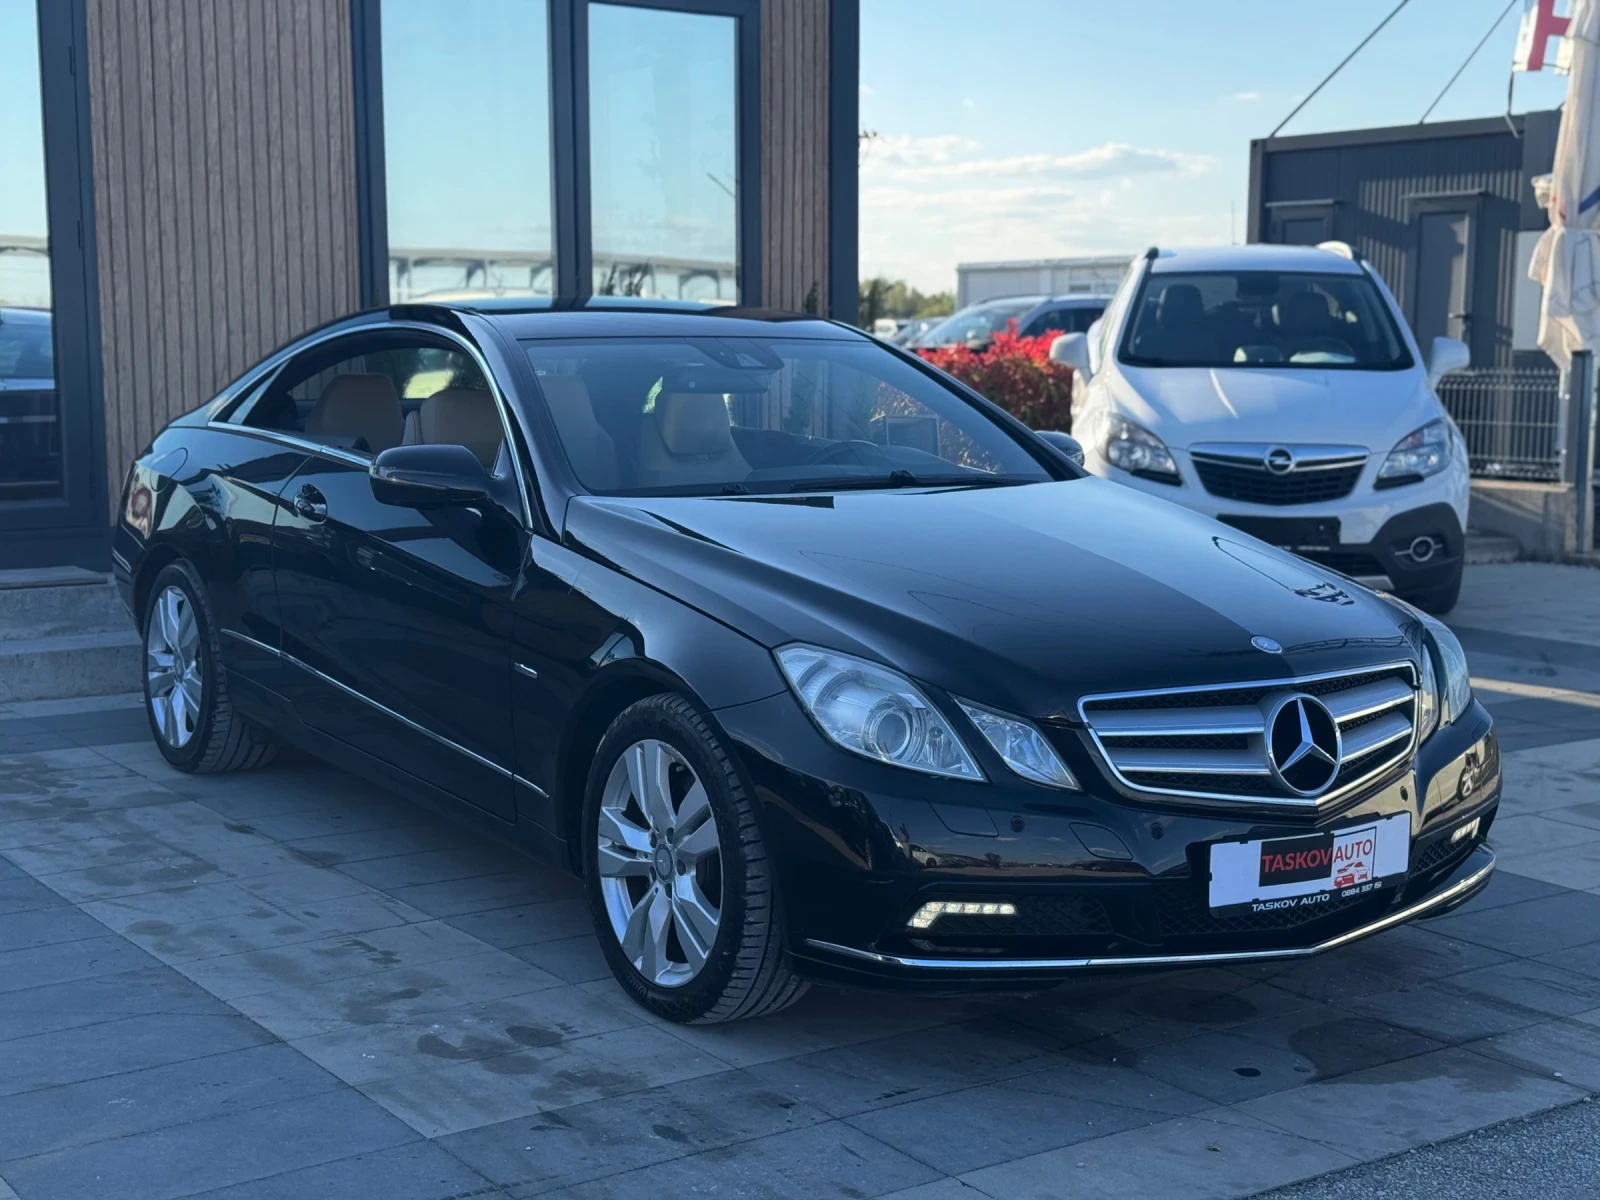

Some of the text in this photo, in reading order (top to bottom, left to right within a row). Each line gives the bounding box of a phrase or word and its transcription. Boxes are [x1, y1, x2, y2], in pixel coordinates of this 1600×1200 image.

[1262, 838, 1373, 873] TASKOV AUTO
[1251, 893, 1330, 912] TASKOV AUTO
